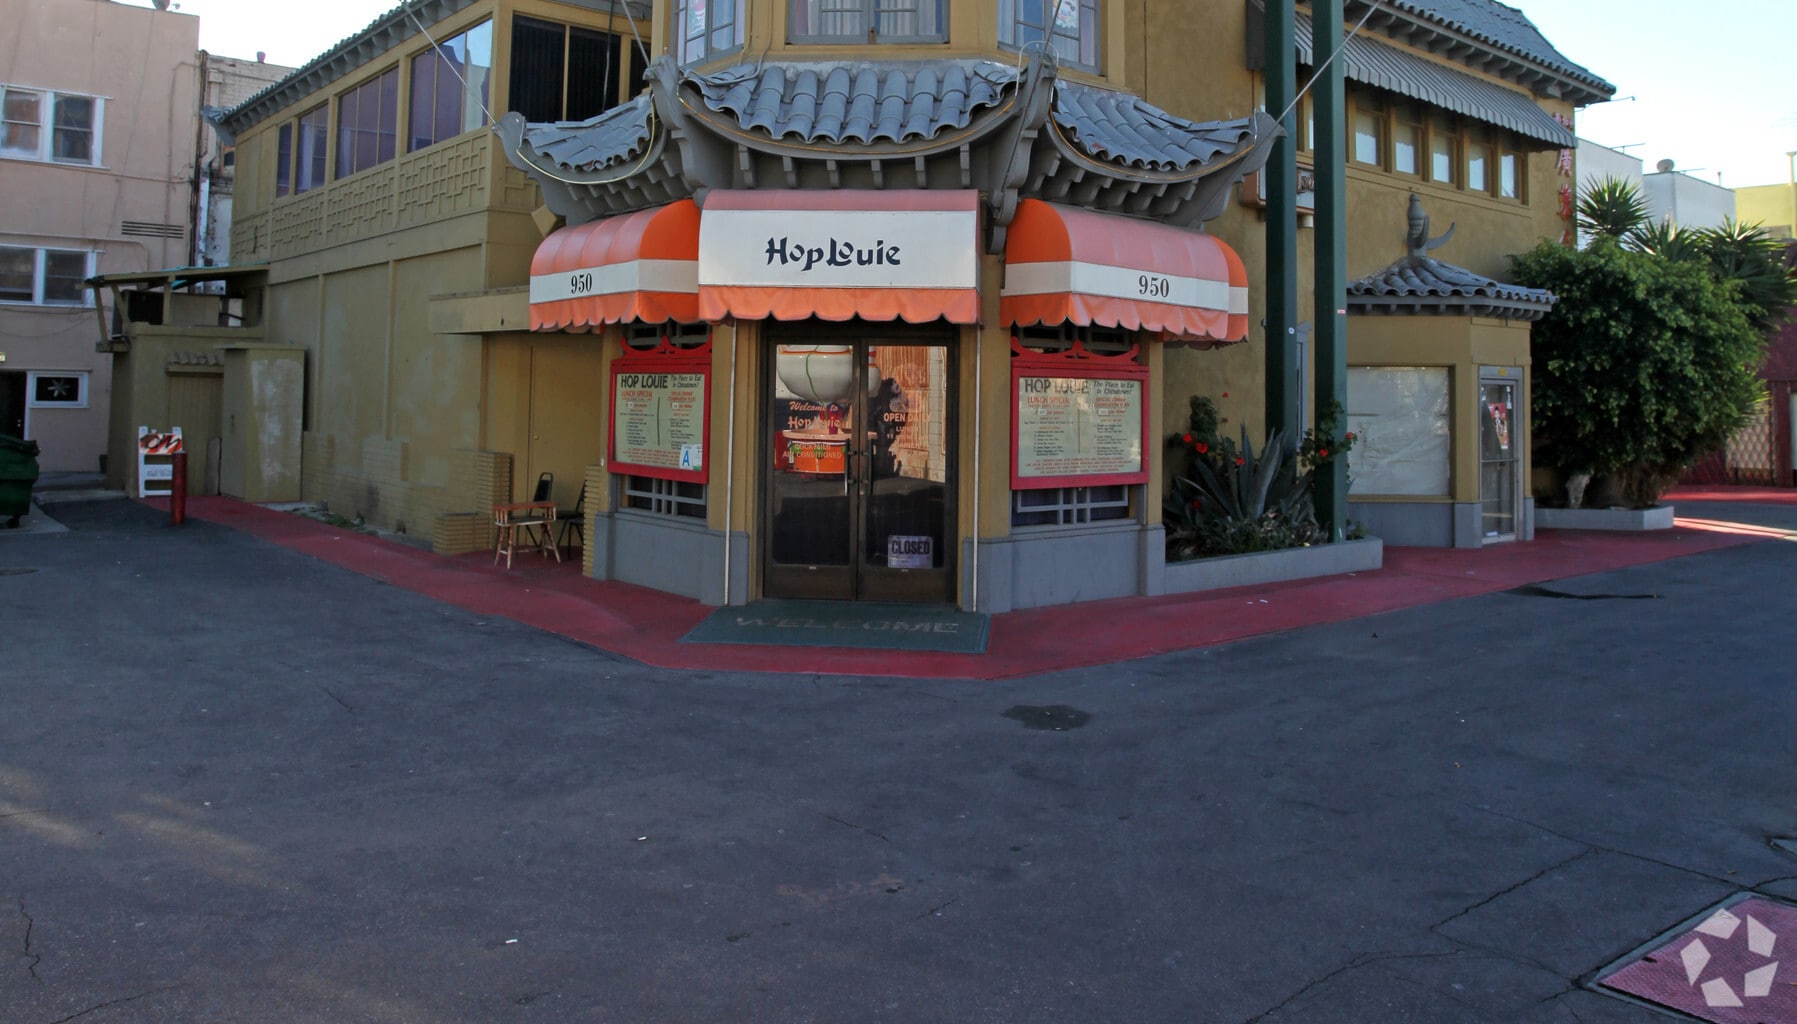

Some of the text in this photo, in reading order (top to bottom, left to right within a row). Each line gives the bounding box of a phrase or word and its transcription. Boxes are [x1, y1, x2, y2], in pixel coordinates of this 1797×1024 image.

[571, 272, 592, 294] 950
[1138, 275, 1169, 298] 950
[620, 374, 668, 389] HOP LOUIE
[1025, 378, 1051, 393] HOP
[789, 401, 839, 412] Welcome to
[788, 415, 811, 430] Hop
[883, 412, 906, 422] OPEN
[682, 450, 690, 467] A
[891, 540, 930, 555] CLOSED
[736, 616, 959, 633] WELCOME
